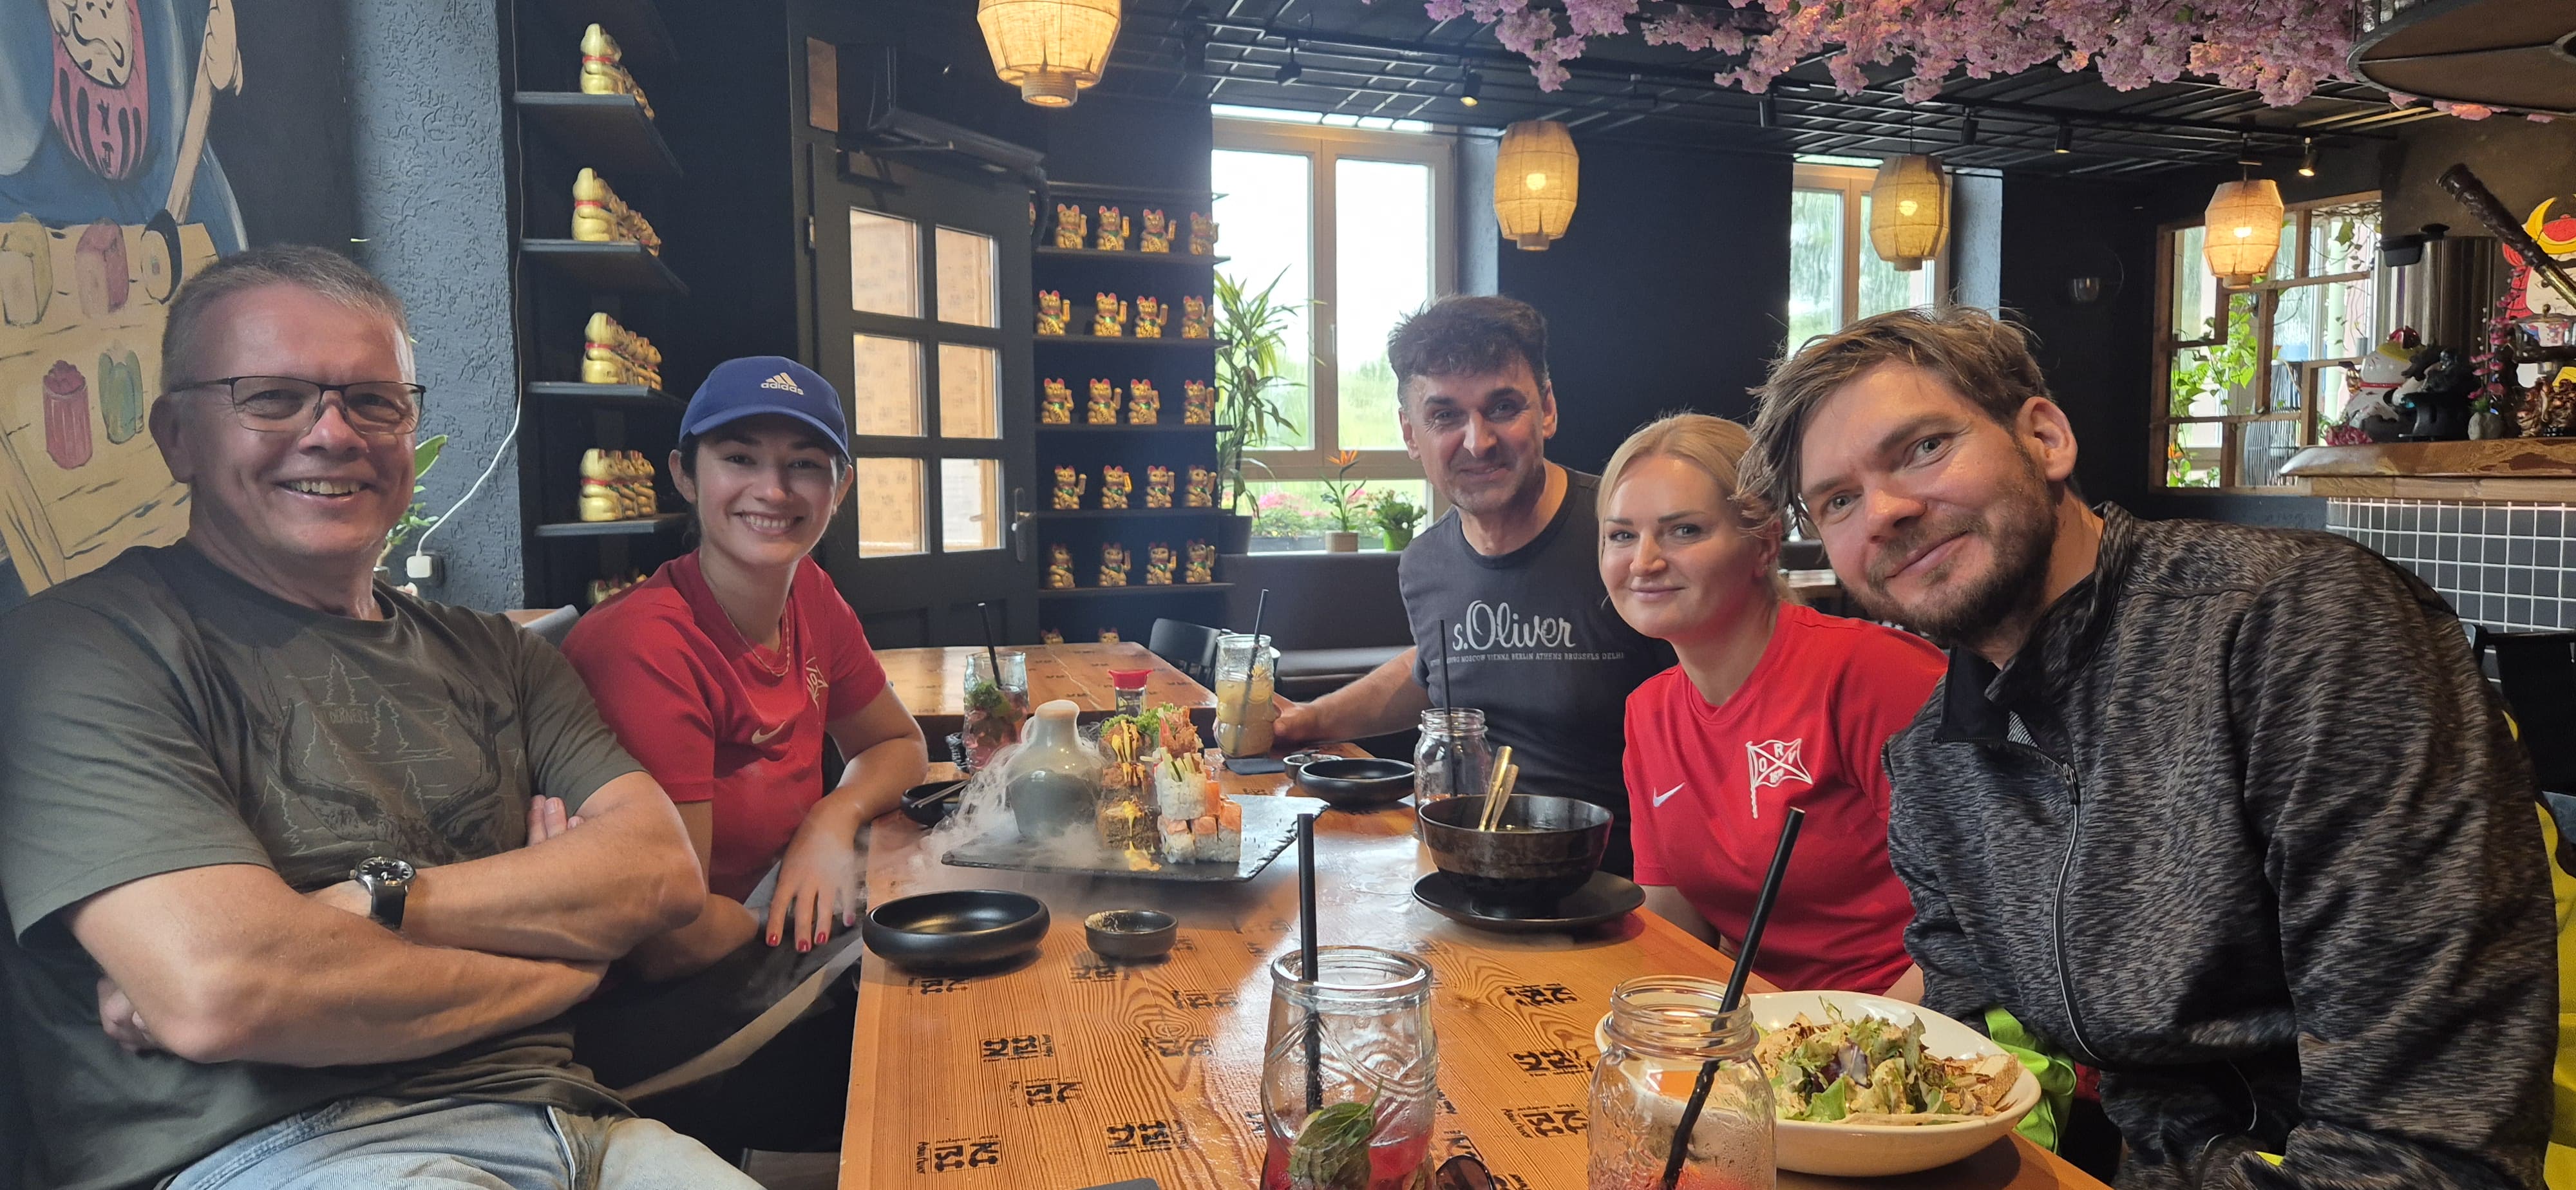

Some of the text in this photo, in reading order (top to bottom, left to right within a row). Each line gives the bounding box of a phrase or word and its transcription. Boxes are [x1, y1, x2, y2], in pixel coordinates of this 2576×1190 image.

[761, 382, 804, 395] adidas
[1453, 600, 1576, 651] s.Oliver
[1461, 654, 1486, 663] MOSCOW
[1487, 653, 1510, 661] VIENNA
[1511, 652, 1533, 661] BERLIN
[1535, 652, 1562, 661] ATHENS
[1564, 652, 1600, 661] BRUSSELS
